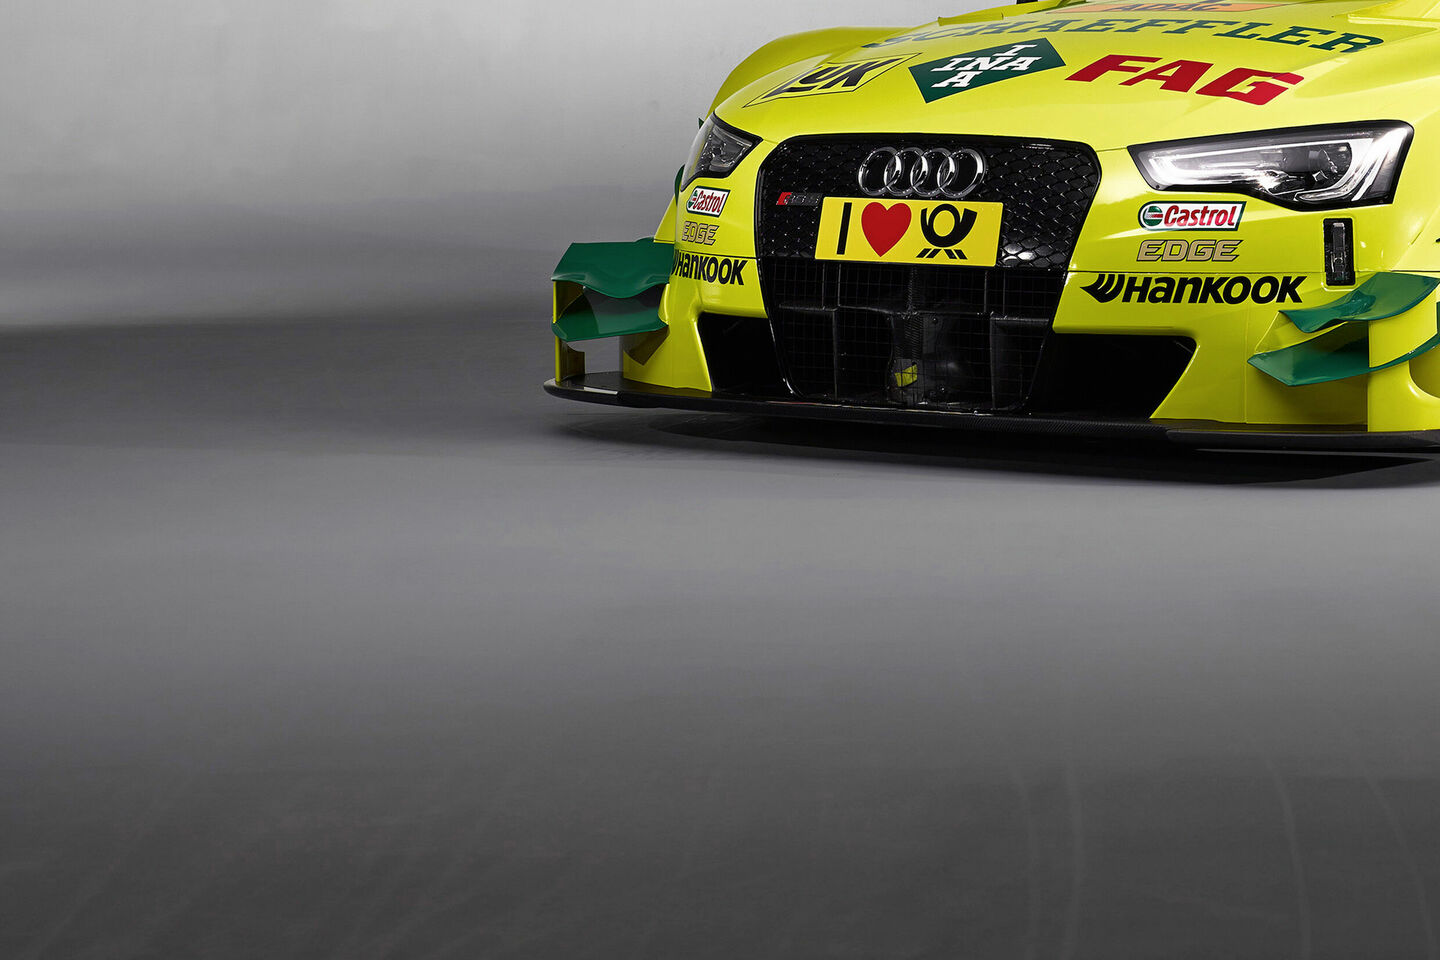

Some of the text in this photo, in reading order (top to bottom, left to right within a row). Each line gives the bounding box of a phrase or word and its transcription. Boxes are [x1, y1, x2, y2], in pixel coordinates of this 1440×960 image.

[1103, 3, 1234, 12] ADAC
[861, 18, 1384, 53] SCHAEFFLER
[1064, 54, 1305, 106] FAG
[693, 190, 725, 214] Castrol
[1164, 203, 1238, 228] Castrol
[682, 220, 720, 246] EDGE
[836, 201, 853, 256] I
[1136, 239, 1244, 262] EDGE
